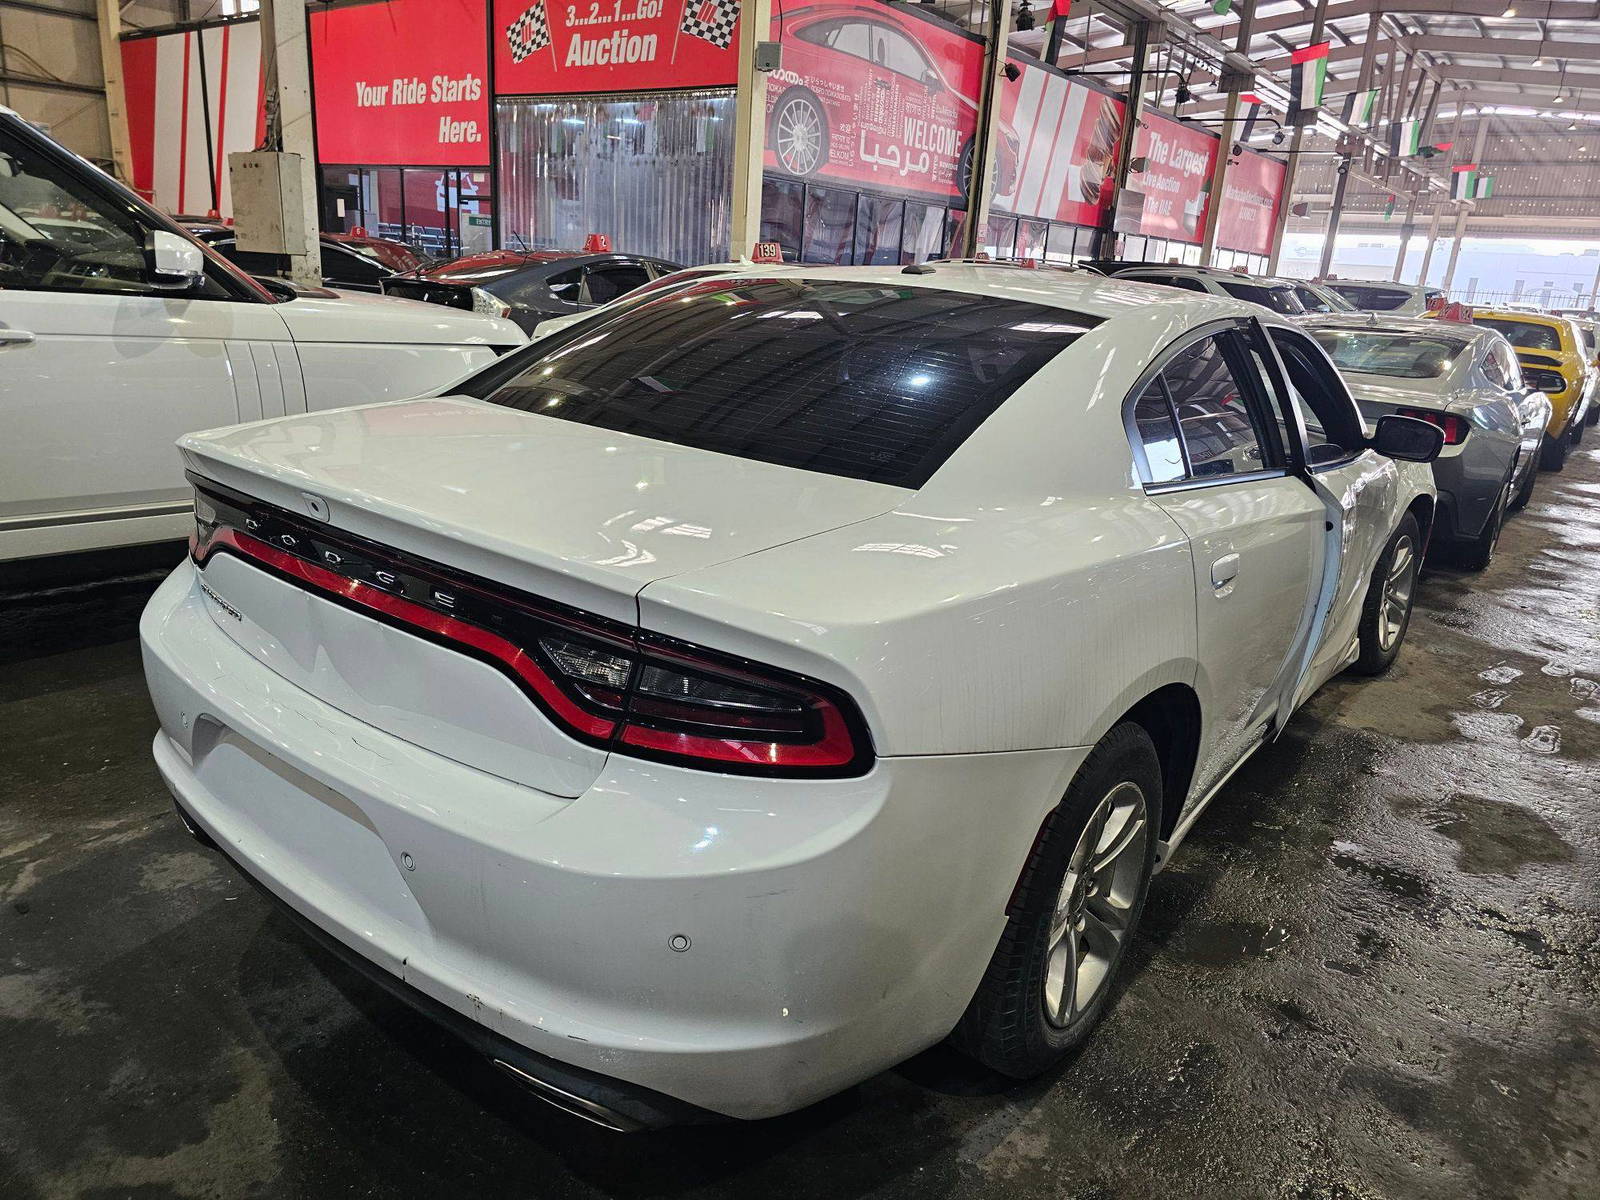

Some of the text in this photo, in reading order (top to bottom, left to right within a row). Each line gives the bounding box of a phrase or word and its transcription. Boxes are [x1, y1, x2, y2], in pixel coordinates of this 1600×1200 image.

[565, 29, 658, 67] Auction
[356, 73, 481, 107] Your Ride Starts
[438, 115, 482, 144] Here.
[903, 116, 963, 158] WELCOME
[859, 129, 930, 177] مرحبا
[1148, 133, 1209, 178] The Largest
[1143, 171, 1180, 193] Live Auction
[1148, 197, 1158, 214] The
[759, 244, 776, 257] 139
[245, 518, 455, 608] DODGE
